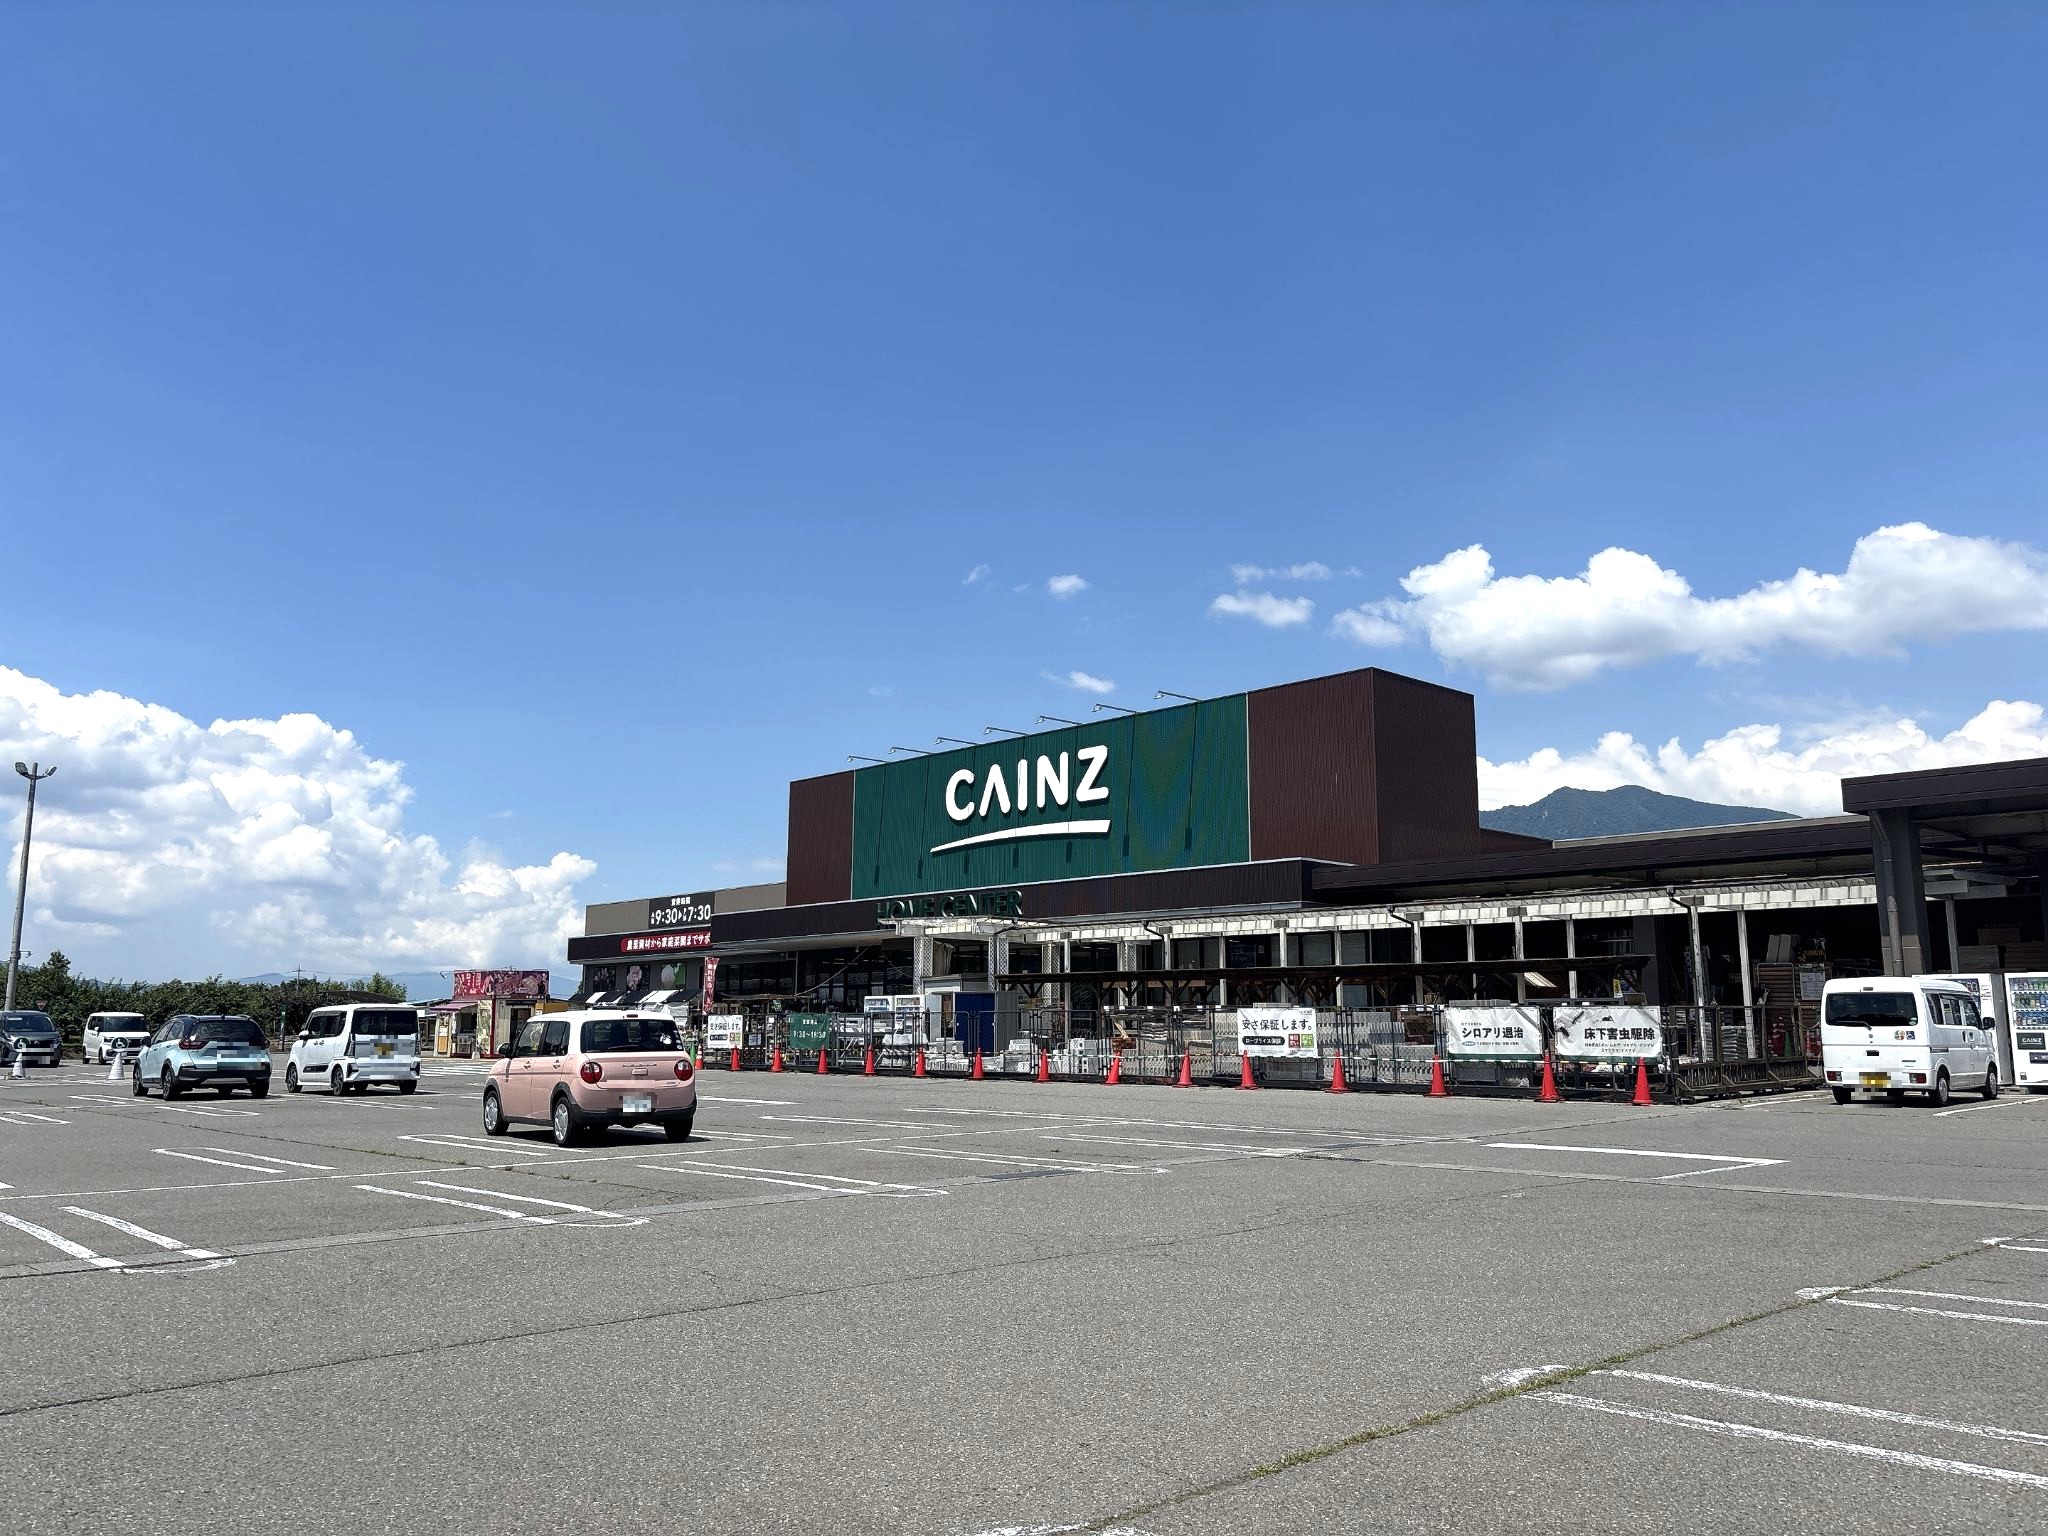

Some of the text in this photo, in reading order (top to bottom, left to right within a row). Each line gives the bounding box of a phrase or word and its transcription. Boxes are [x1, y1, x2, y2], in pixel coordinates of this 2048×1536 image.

[945, 745, 1109, 821] CAINZ
[876, 890, 1023, 918] HOME CENTER
[1242, 1019, 1312, 1031] 安さ保証します。
[1462, 1026, 1524, 1039] シロアリ退治
[1584, 1027, 1655, 1040] 床下害虫駆除
